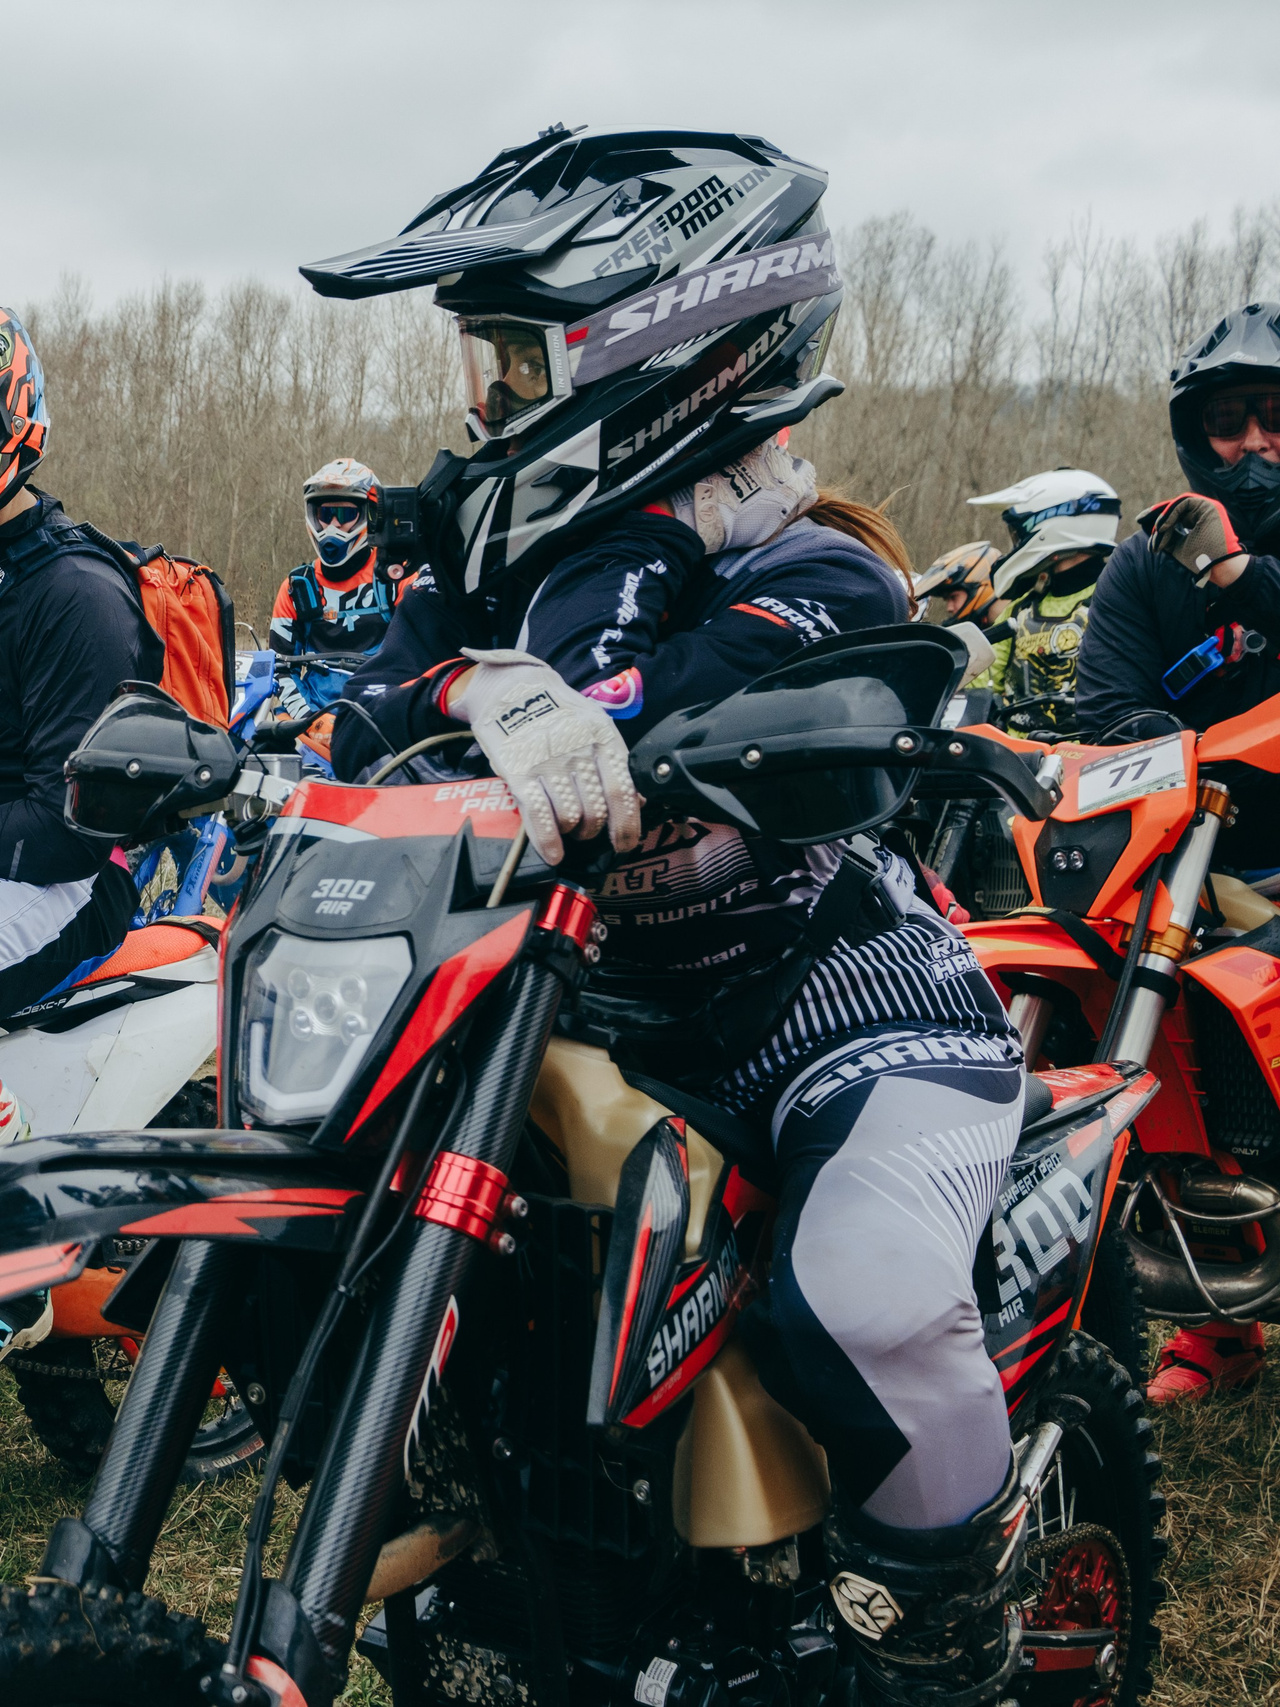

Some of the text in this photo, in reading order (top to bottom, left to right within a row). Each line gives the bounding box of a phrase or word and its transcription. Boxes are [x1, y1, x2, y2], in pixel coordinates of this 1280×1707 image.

[592, 174, 725, 278] FREEDOM
[640, 166, 771, 266] IN MOTION
[607, 310, 788, 470] SHARMAX
[621, 420, 710, 491] ADVENTURE AWAITS
[1109, 756, 1152, 788] 77
[311, 878, 376, 900] 300
[315, 900, 354, 916] AIR
[635, 879, 759, 926] AWAITS
[1231, 1146, 1260, 1157] ONLY1
[998, 1151, 1063, 1213] EXPERT PRO
[992, 1167, 1094, 1306] 300
[998, 1296, 1026, 1328] AIR
[727, 1669, 760, 1688] SHARMAX
